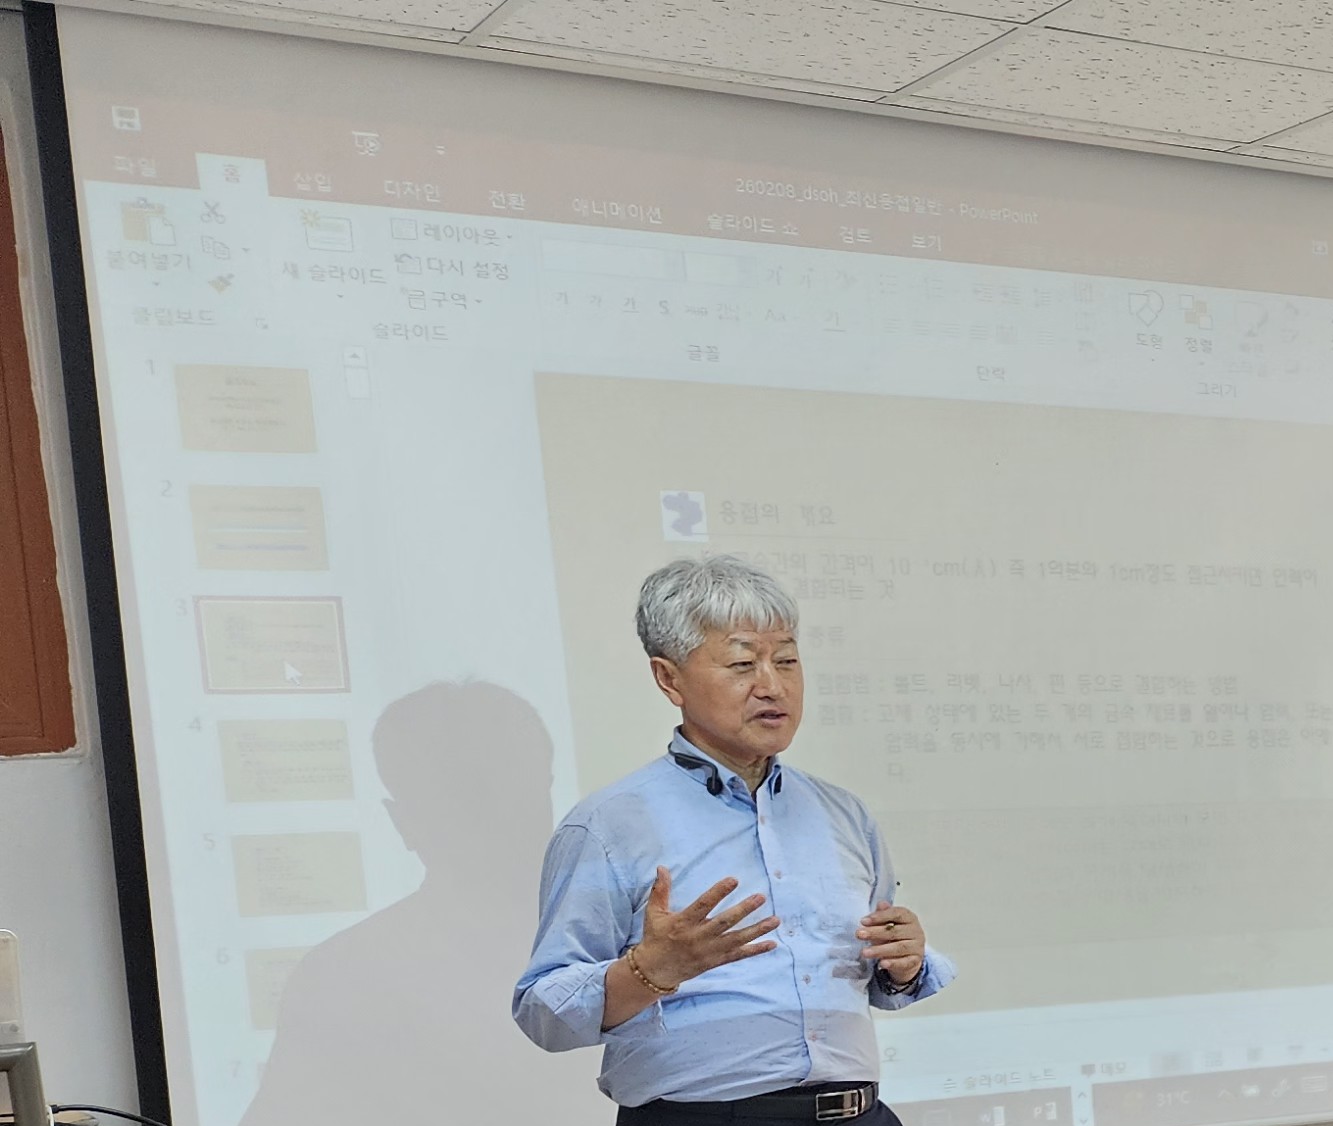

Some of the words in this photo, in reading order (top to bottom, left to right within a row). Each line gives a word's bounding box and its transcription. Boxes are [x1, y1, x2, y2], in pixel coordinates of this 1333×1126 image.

[112, 156, 157, 178] 파일
[222, 164, 241, 184] 홈
[292, 171, 333, 193] 삽입
[383, 179, 441, 203] 디자인
[488, 190, 527, 211] 전환
[571, 198, 662, 224] 애니메이션
[706, 213, 776, 234] 슬라이드
[783, 221, 799, 236] 쇼
[960, 204, 1040, 226] PowerPoint
[423, 222, 500, 246] 레이아웃
[839, 226, 872, 244] 검토
[911, 233, 942, 252] 보기
[106, 249, 192, 272] 붙여넣기
[427, 257, 464, 278] 다시
[473, 261, 510, 282] 설정
[282, 261, 300, 280] 새
[308, 264, 388, 285] 슬라이드
[431, 290, 467, 310] 구역
[132, 306, 216, 327] 클립보드
[373, 323, 448, 341] 슬라이드
[1135, 332, 1164, 350] 도형
[687, 344, 721, 363] 글꼴
[1184, 335, 1213, 354] 정렬
[976, 364, 1007, 383] 단락
[1197, 381, 1238, 399] 그리기
[159, 480, 175, 497] 2
[719, 500, 780, 525] 용접의
[1009, 559, 1025, 577] 즉
[1077, 674, 1123, 694] 등으로
[962, 1068, 1023, 1090] 슬라이드
